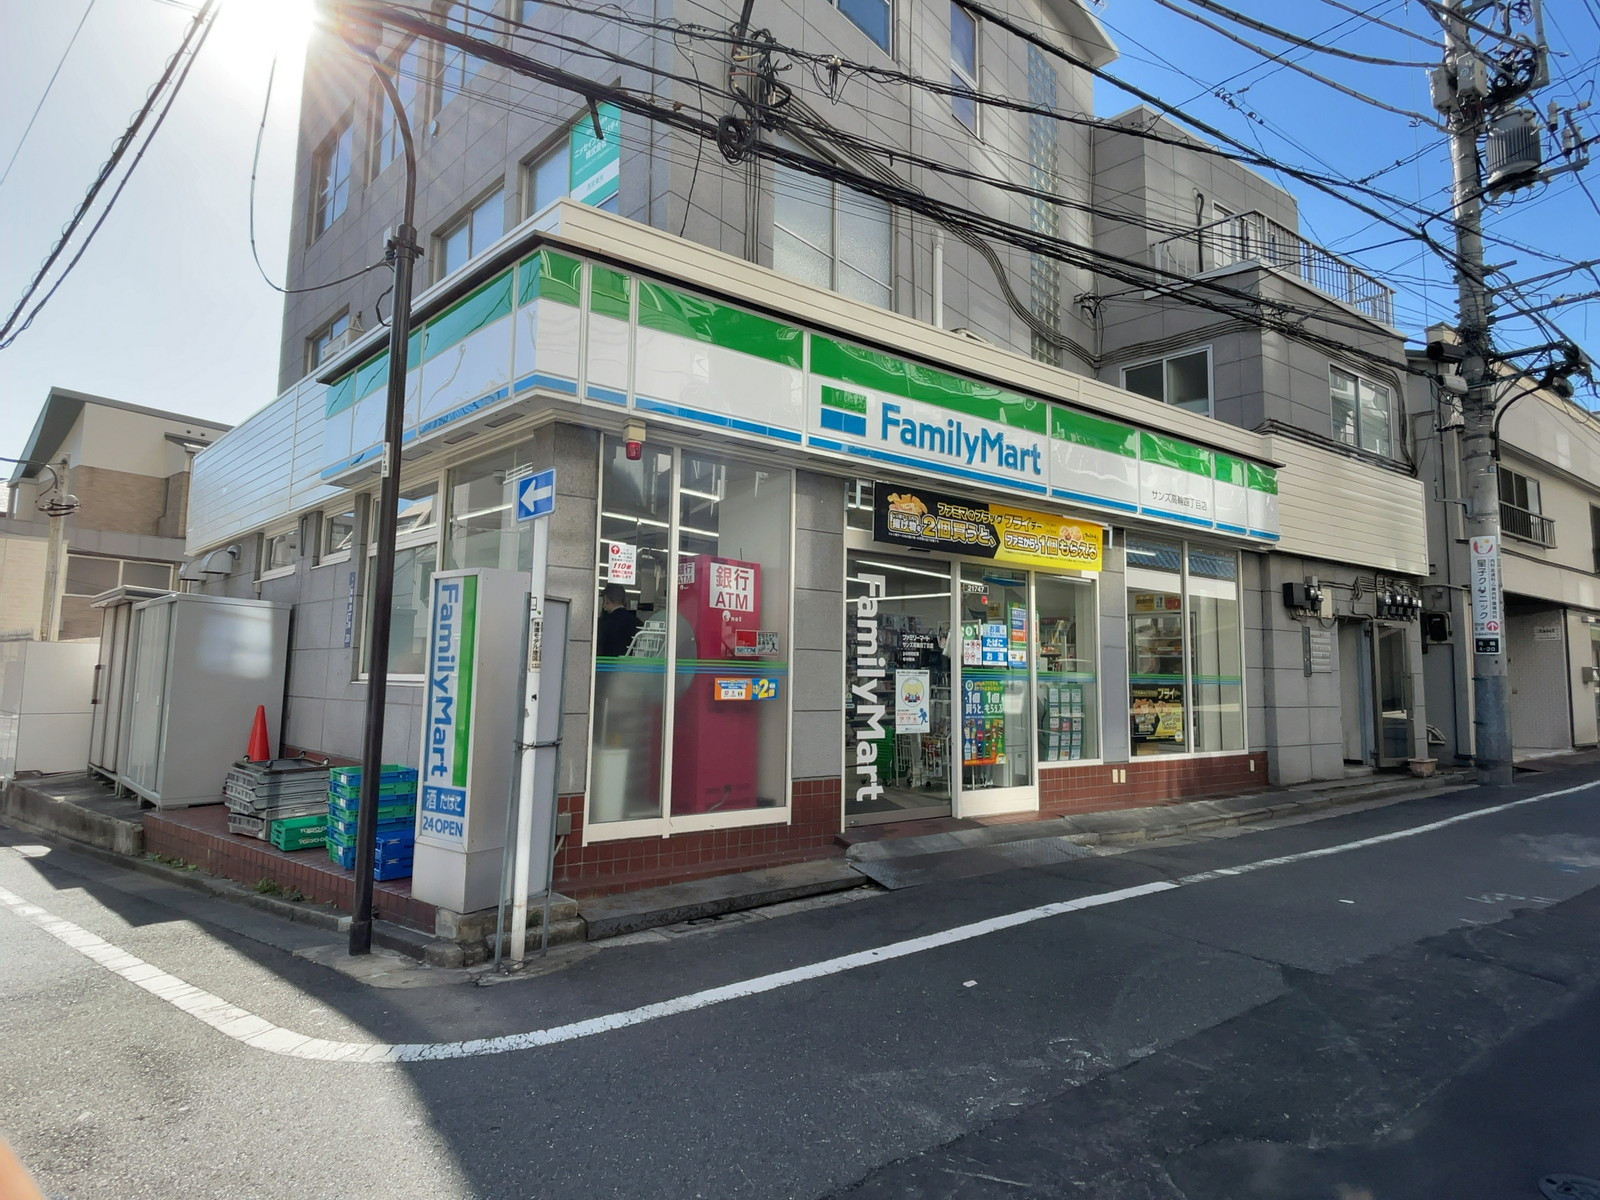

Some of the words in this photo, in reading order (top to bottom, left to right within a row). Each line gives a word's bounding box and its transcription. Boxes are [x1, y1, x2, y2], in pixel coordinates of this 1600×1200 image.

[881, 402, 1041, 475] FamilyMart
[678, 575, 692, 584] ATM
[716, 566, 749, 591] 銀行
[967, 585, 985, 593] 21747
[715, 591, 748, 610] ATM
[986, 638, 1004, 647] たばこ
[431, 583, 459, 777] FamilyMart
[852, 573, 886, 801] FamilyMart
[426, 789, 437, 809] 酒
[440, 793, 461, 811] たばこ
